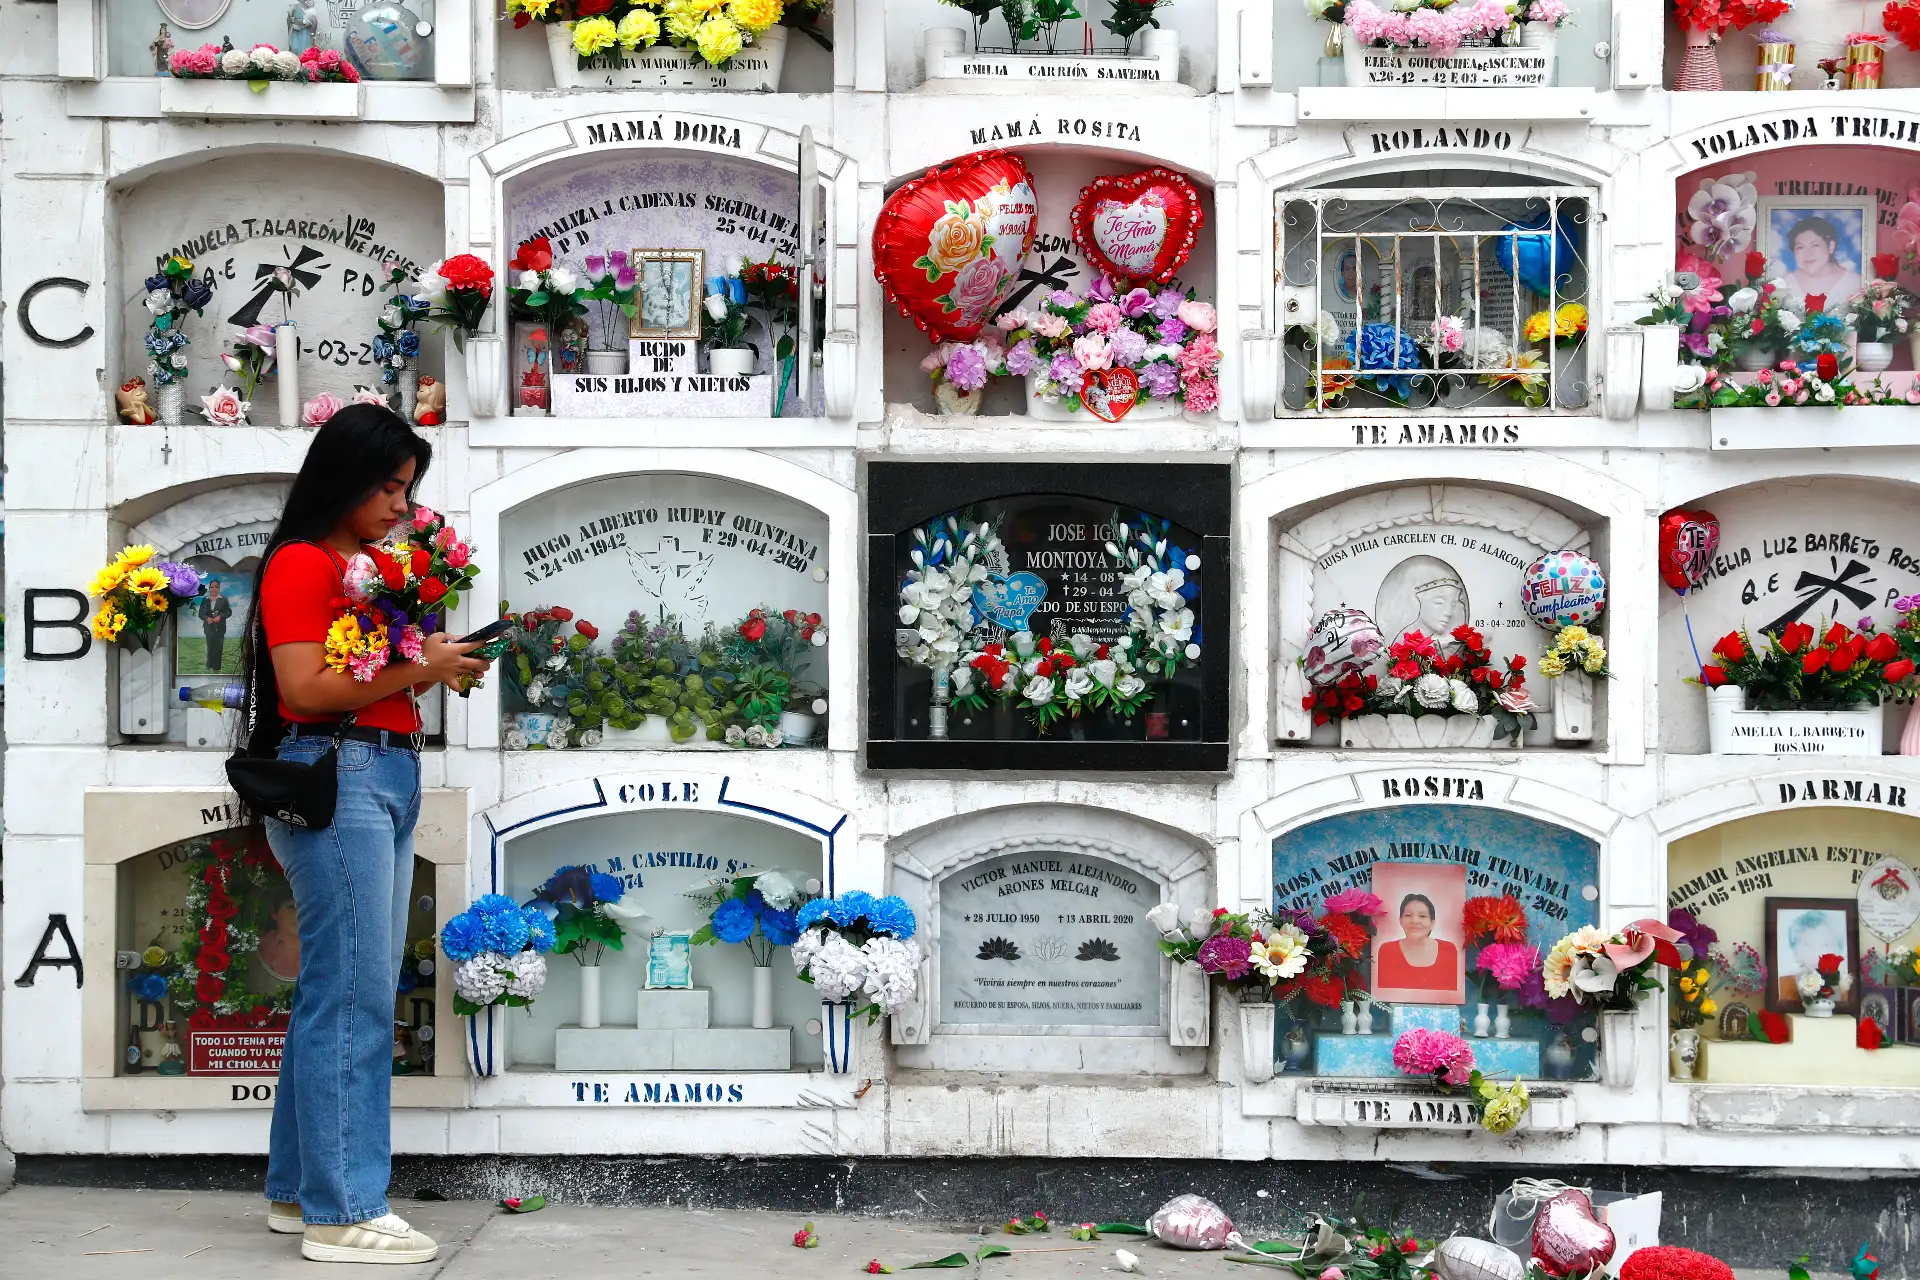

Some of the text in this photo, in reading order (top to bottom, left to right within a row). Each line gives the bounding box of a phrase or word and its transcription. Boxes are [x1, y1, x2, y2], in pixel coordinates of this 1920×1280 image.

[963, 63, 1161, 81] EMILIA CARRIÓN SAAVEDRA
[1364, 56, 1403, 69] ELENA
[1408, 57, 1477, 70] GOICOCHEA
[1487, 57, 1546, 69] ASCENCIO
[605, 75, 613, 86] 4
[710, 76, 727, 88] 20
[586, 113, 741, 148] MAMÁ DORA
[970, 113, 1141, 145] MAMÁ ROSITA
[1691, 116, 1920, 159] YOLANDA TRUJI
[1371, 127, 1511, 153] ROLANDO
[1774, 180, 1899, 207] TRUJILLO DE
[519, 206, 600, 247] ORALIZA
[619, 192, 697, 213] CADENAS
[704, 194, 768, 225] SEGURA
[768, 209, 790, 234] DE
[1104, 215, 1157, 242] Te Amo
[1108, 241, 1156, 261] Mamá
[17, 276, 95, 349] C
[639, 341, 686, 357] RCDO
[653, 357, 674, 373] DE
[575, 376, 751, 394] SUS HIJOS Y NIETOS
[1352, 425, 1520, 445] TE AMAMOS
[522, 507, 818, 566] HUGO ALBERTO RUPAY QUINTANA
[1048, 524, 1086, 542] JOSE
[1685, 526, 1704, 549] TE
[195, 532, 270, 555] ARIZA ELVIR
[1318, 533, 1526, 571] LUISA JULIA CARCELEN CH. DE ALARCON
[1026, 551, 1109, 569] MONTOYA
[1763, 536, 1798, 559] LUZ
[1805, 532, 1880, 560] BARRETO
[1888, 547, 1920, 577] ROS
[1024, 585, 1037, 595] Te
[1530, 577, 1586, 601] FELIZ
[1013, 594, 1039, 606] Amo
[1036, 602, 1128, 613] CDO DE SU ESPO
[1529, 594, 1597, 620] Cumpleaños
[994, 605, 1025, 619] Papá
[24, 588, 92, 661] B
[1731, 725, 1783, 737] AMELIA
[1803, 726, 1865, 739] BARRETO
[1774, 742, 1825, 753] ROSADO
[619, 782, 700, 803] COLE
[1382, 775, 1484, 800] ROSITA
[1779, 779, 1907, 807] DARMAR
[632, 851, 719, 871] CASTILLO
[961, 860, 1137, 895] VICTOR MANUEL ALEJANDRO
[1274, 842, 1570, 901] ROSA NILDA AHUANARI TUANAMA
[1667, 867, 1728, 910] DARMAR
[1735, 846, 1819, 876] ANGELINA
[998, 879, 1100, 898] ARONES MELGAR
[973, 913, 1040, 924] 28 JULIO 1950
[1066, 914, 1134, 924] 13 ABRIL 2020
[14, 913, 84, 990] A
[1007, 978, 1036, 989] siempre
[1048, 979, 1079, 987] nuestros
[954, 1001, 988, 1009] RECUERDO
[988, 1001, 997, 1009] DE
[998, 1001, 1006, 1009] SU
[195, 1037, 286, 1046] TODO LO TENIA PER
[208, 1049, 283, 1057] CUANDO TU PAR
[208, 1060, 270, 1069] MI CHOLA
[572, 1082, 744, 1103] TE AMAMOS
[1353, 1100, 1485, 1124] TE AMAM
